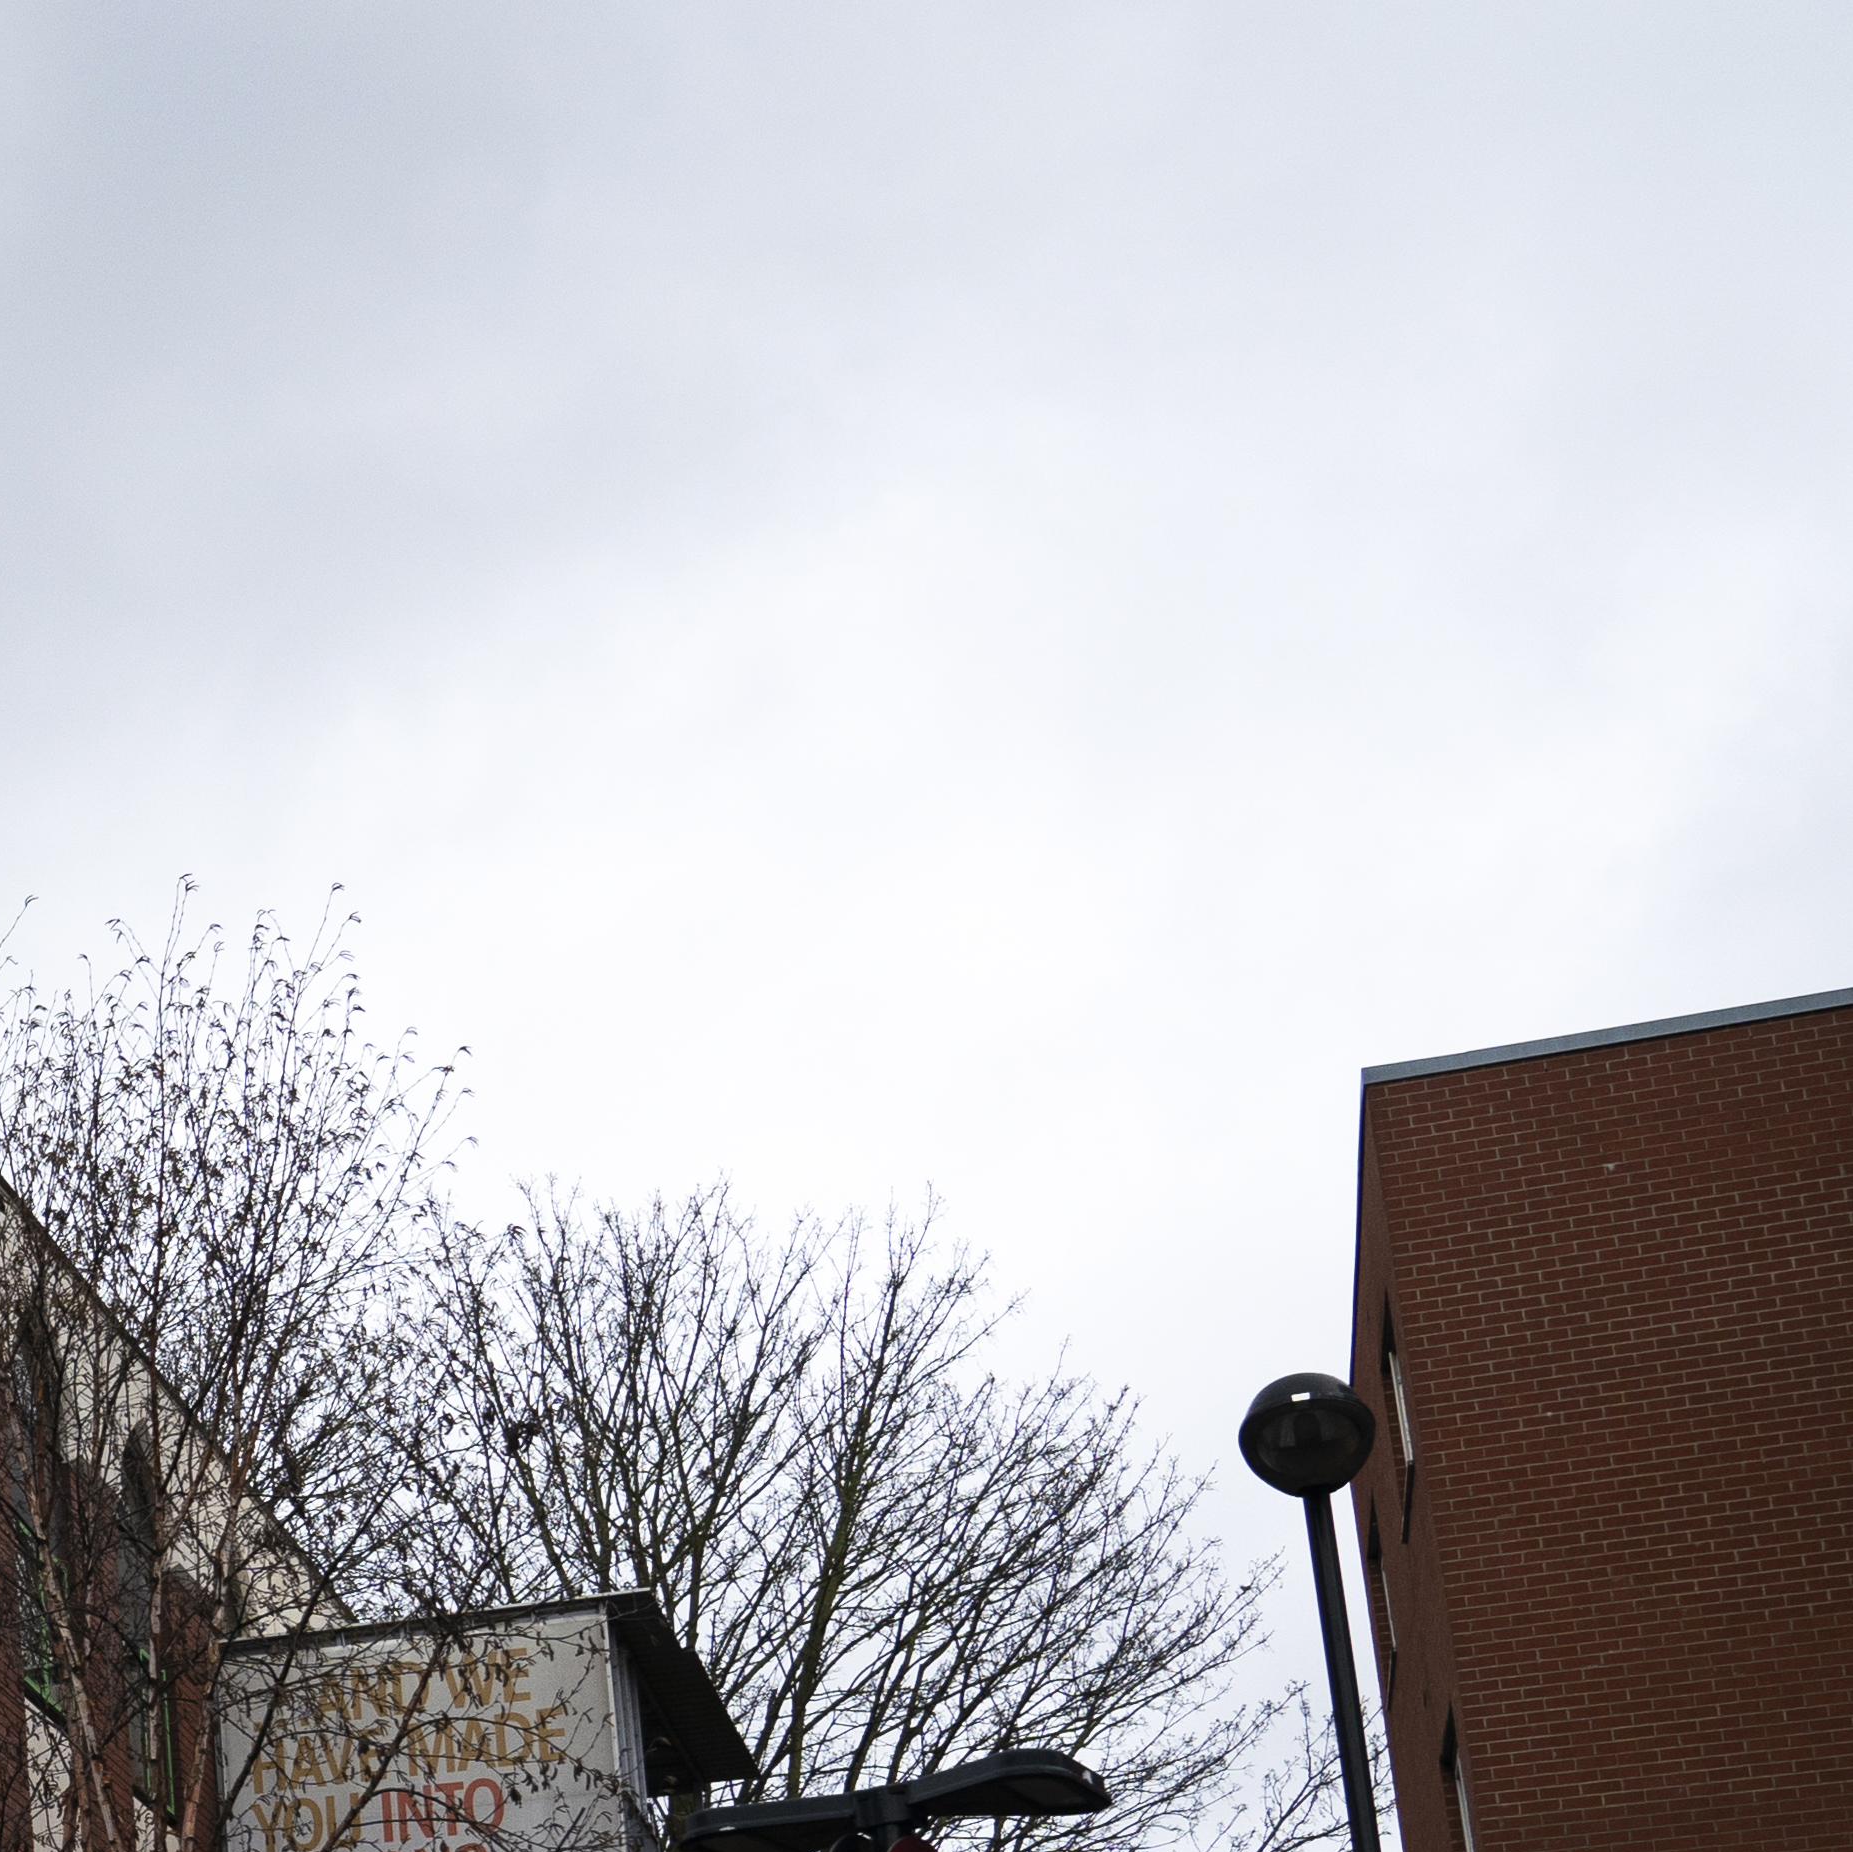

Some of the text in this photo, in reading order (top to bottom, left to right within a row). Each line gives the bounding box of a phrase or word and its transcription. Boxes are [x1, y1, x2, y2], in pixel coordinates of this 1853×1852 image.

[445, 1647, 531, 1709] WE
[252, 1707, 567, 1794] HAVE MADE
[380, 1777, 505, 1843] INTO
